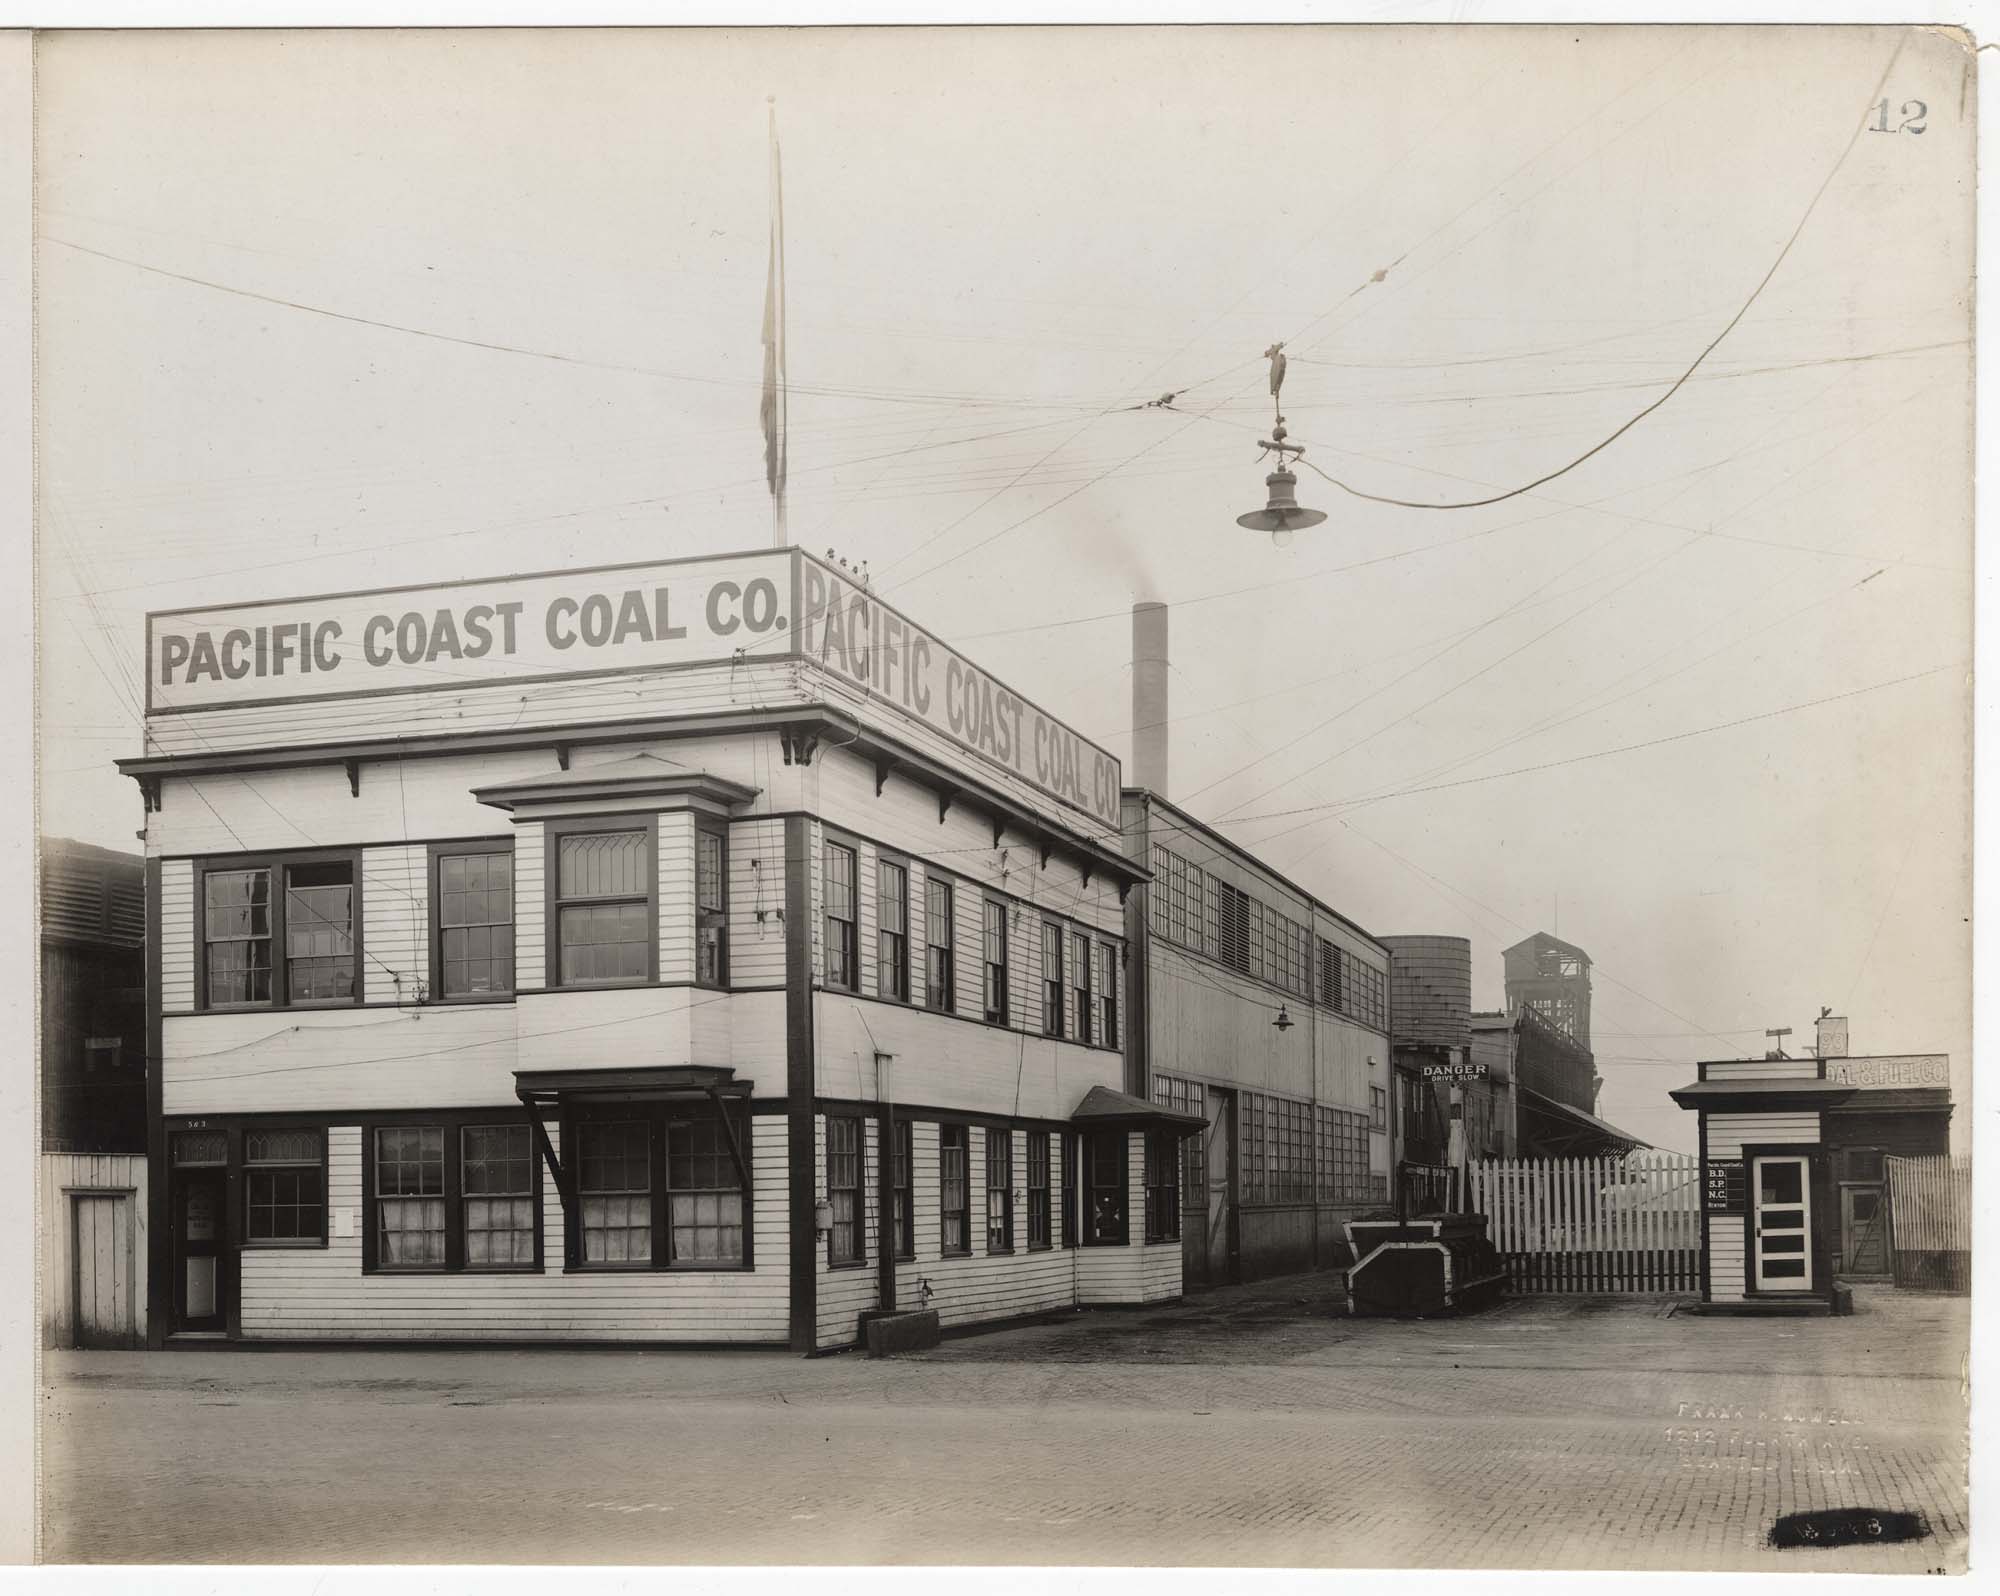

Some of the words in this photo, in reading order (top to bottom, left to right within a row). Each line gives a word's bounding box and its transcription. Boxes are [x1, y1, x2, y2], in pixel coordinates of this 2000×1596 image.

[162, 620, 343, 686] PACIFIC
[363, 602, 523, 667] COAST
[545, 587, 688, 650] COAL
[705, 577, 788, 636] CO.
[805, 561, 931, 715] PACIFIC
[946, 657, 1024, 771] COAST
[1033, 715, 1088, 805] COAL
[1423, 1065, 1487, 1076] DANGER
[1708, 1180, 1725, 1188] S.P.
[1708, 1190, 1727, 1199] N.C.
